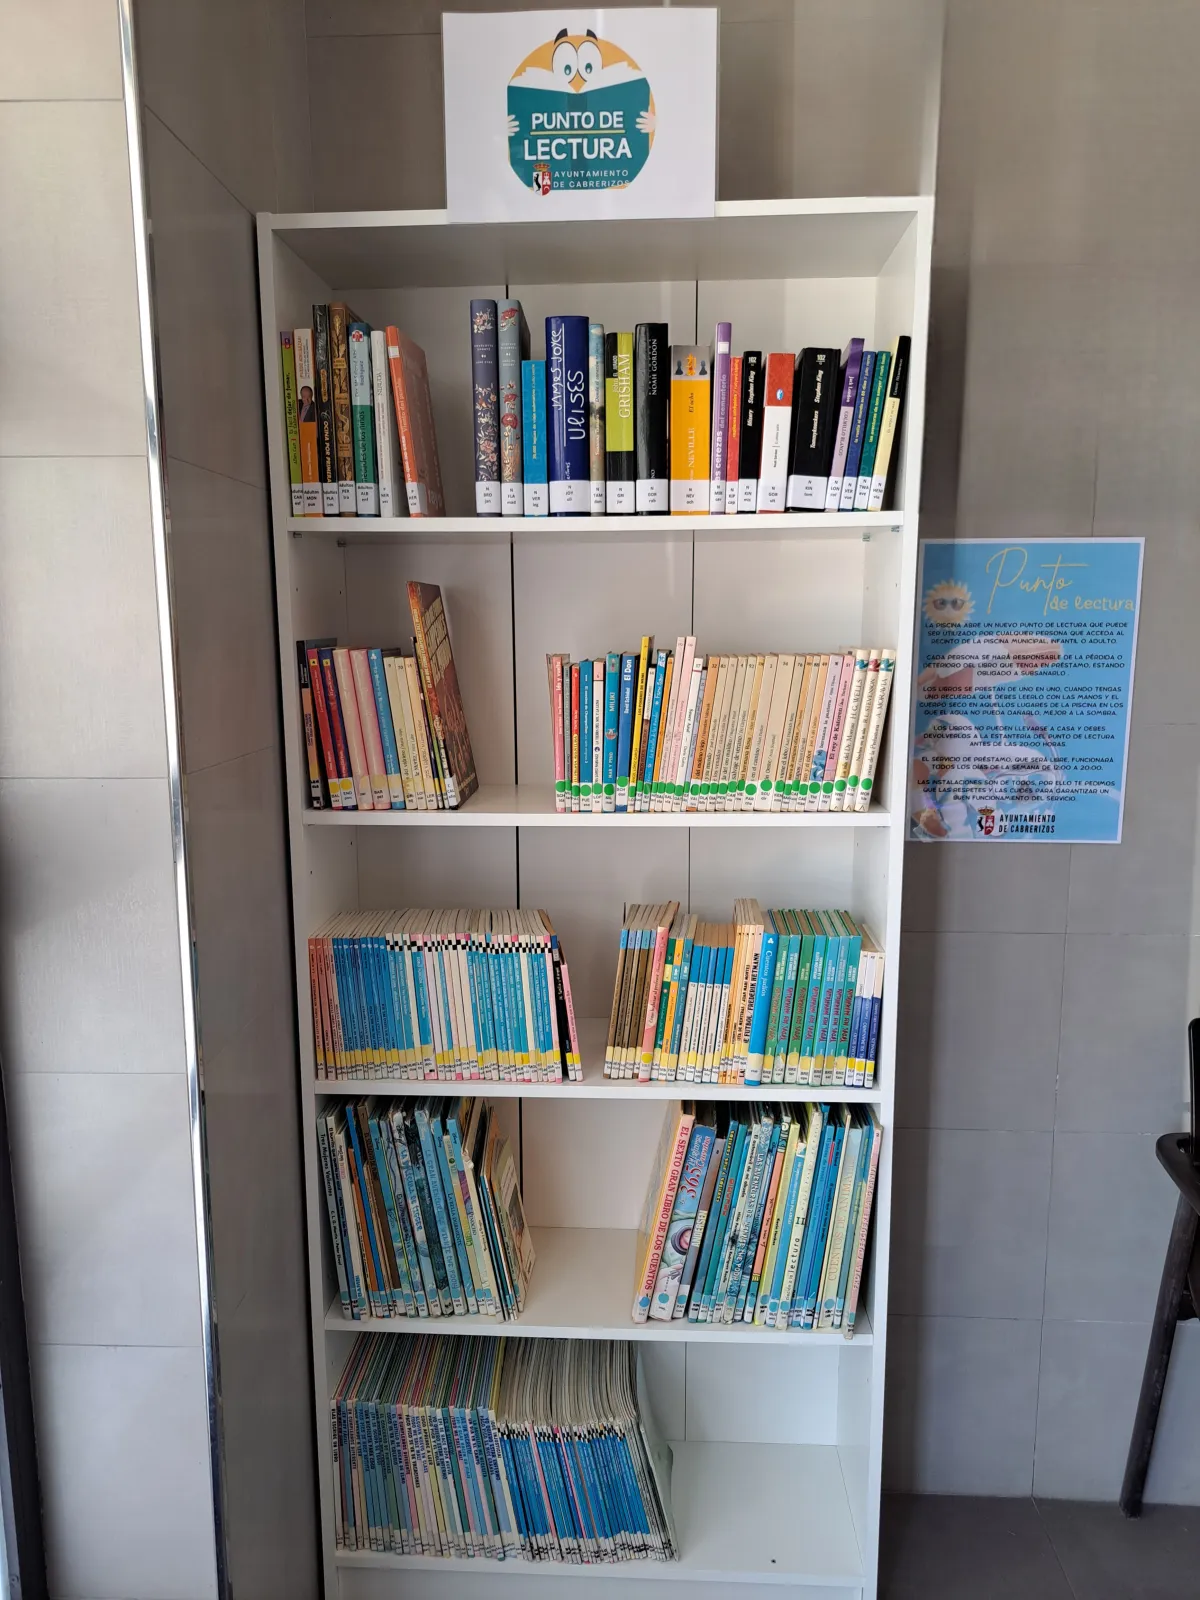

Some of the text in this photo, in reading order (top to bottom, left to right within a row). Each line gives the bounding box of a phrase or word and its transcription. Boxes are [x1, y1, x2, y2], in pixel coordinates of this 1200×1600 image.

[531, 111, 624, 130] PUNTO DE
[524, 137, 632, 160] LECTURA
[554, 170, 629, 178] AYUNTAMIENTO
[569, 179, 630, 188] CABRERIZOS
[618, 354, 630, 419] GRISHAM
[814, 382, 822, 404] Stephen
[567, 370, 586, 440] ULISES
[810, 410, 819, 448] Tommyknockers
[986, 547, 1090, 616] Punto
[1050, 596, 1135, 612] de lectura
[852, 679, 862, 704] WELLS
[998, 825, 1055, 833] DE CABRERIZOS
[1000, 814, 1056, 823] AYUNTAMIENTO
[644, 1126, 689, 1290] EL SEXTO GRAN LIBRO DE LOS CUENTOS
[693, 1210, 707, 1248] ANDERSEN
[788, 1238, 800, 1272] lectura
